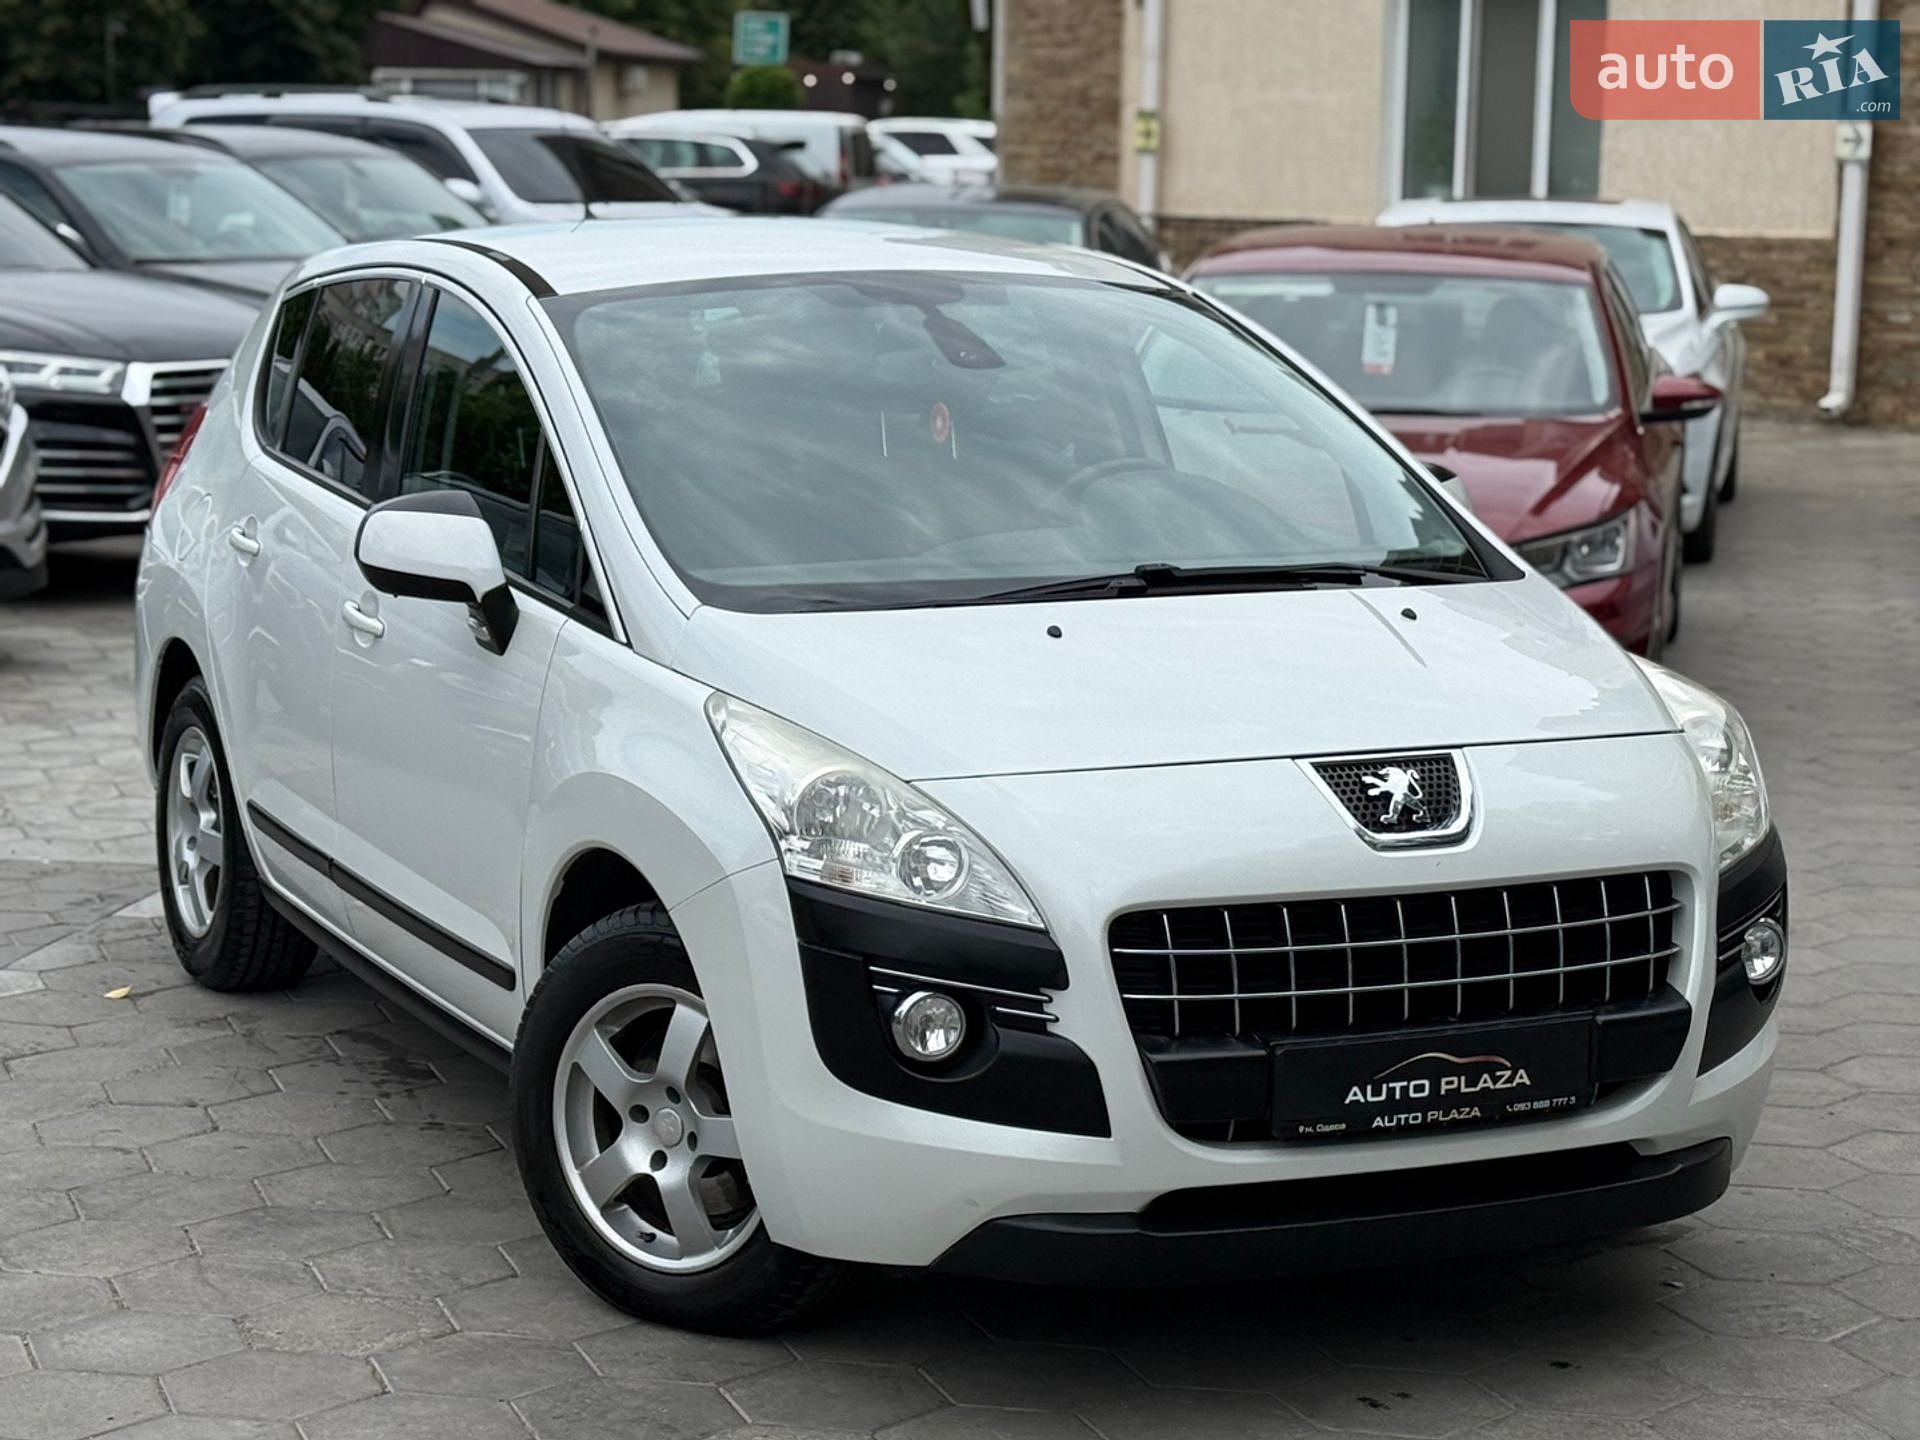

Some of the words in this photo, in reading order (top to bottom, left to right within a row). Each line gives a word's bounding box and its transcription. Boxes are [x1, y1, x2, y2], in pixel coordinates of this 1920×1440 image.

[1344, 1079, 1430, 1104] AUTO
[1440, 1068, 1531, 1095] PLAZA
[1372, 1112, 1422, 1128] AUTO
[1427, 1106, 1481, 1123] PLAZA
